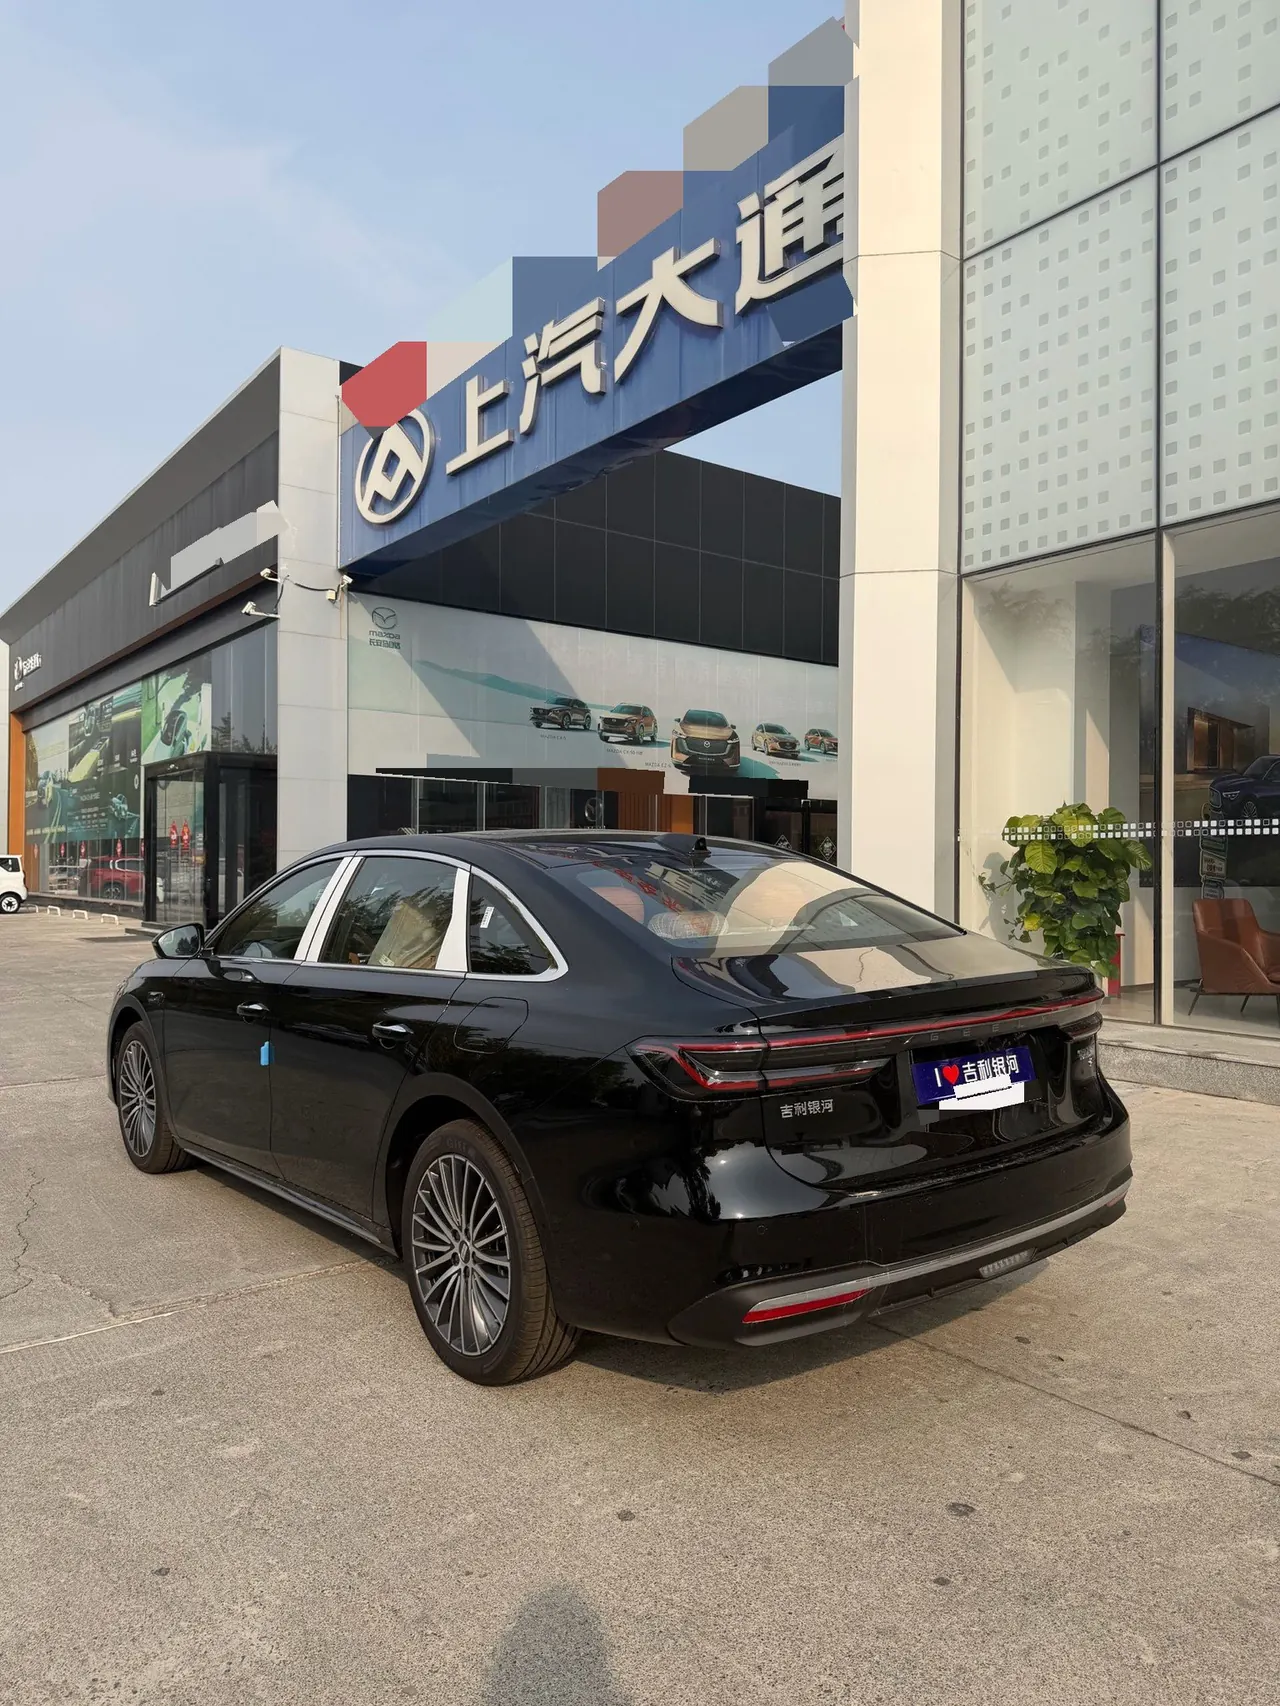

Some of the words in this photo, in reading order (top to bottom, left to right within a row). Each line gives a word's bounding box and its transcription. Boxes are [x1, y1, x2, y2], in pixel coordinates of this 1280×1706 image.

[446, 135, 844, 476] 上汽大通
[962, 1055, 1020, 1083] 吉利银河
[780, 1099, 834, 1119] 吉利银河
